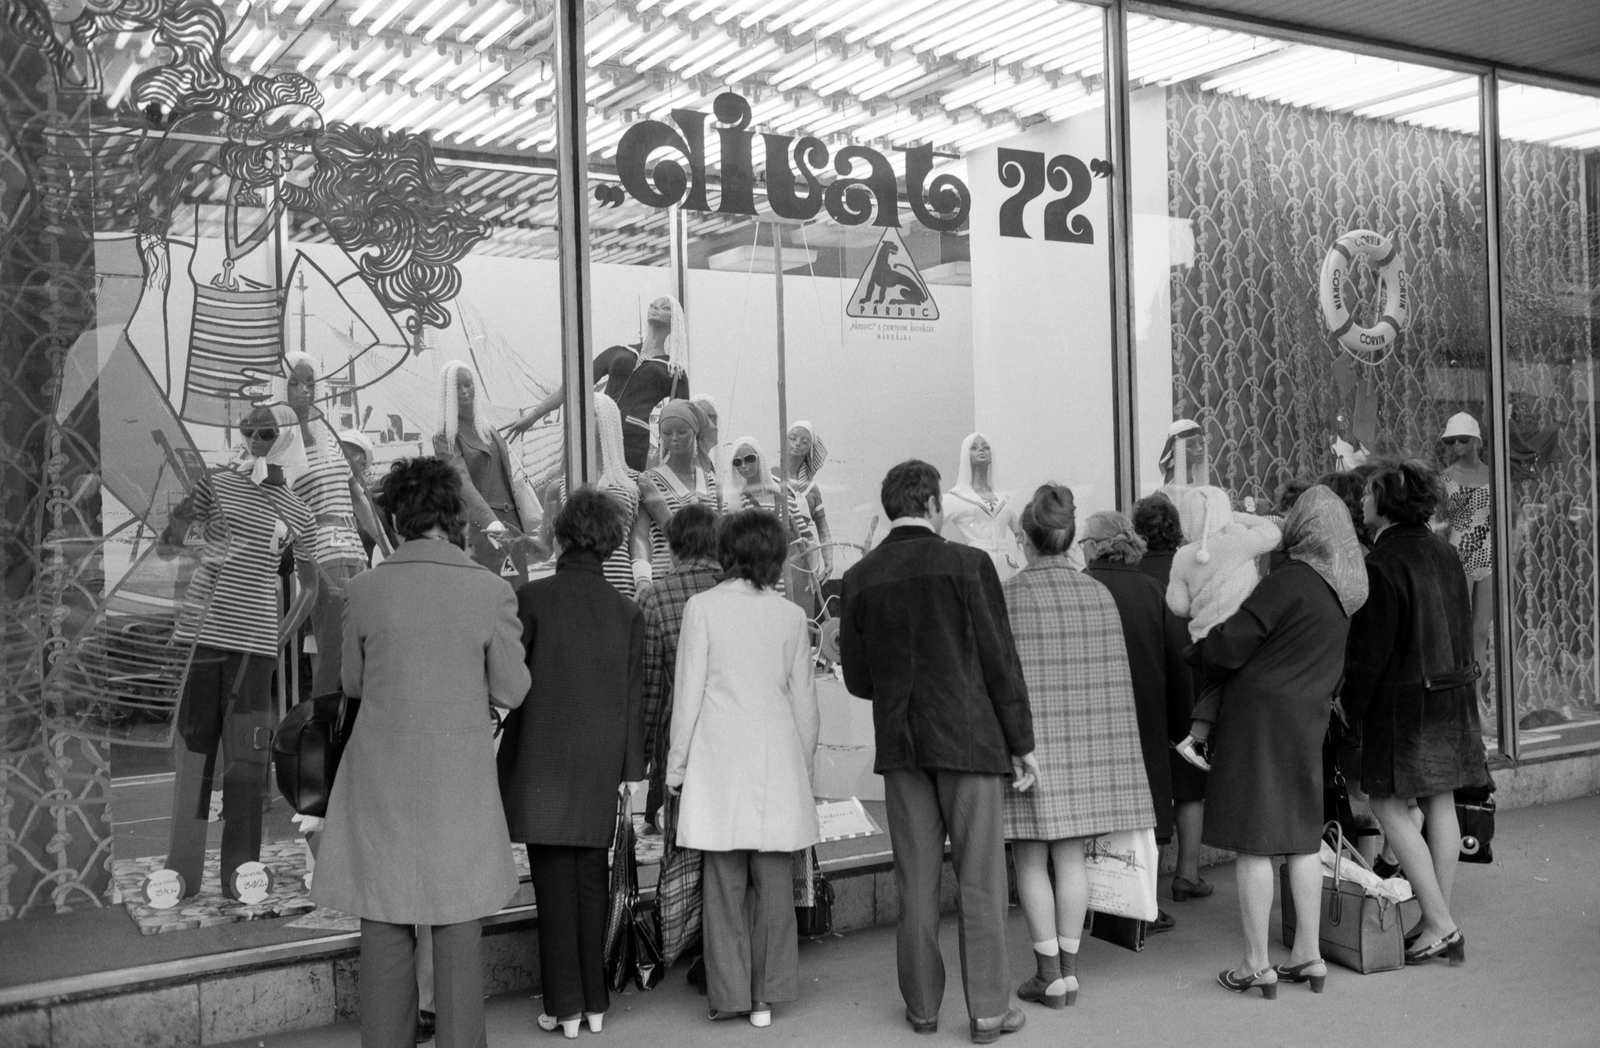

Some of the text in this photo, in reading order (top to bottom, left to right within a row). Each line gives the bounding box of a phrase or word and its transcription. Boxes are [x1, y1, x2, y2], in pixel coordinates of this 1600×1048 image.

[1332, 269, 1343, 310] CORVIN
[1398, 270, 1407, 310] CORVIN
[1360, 333, 1386, 346] CORVIN
